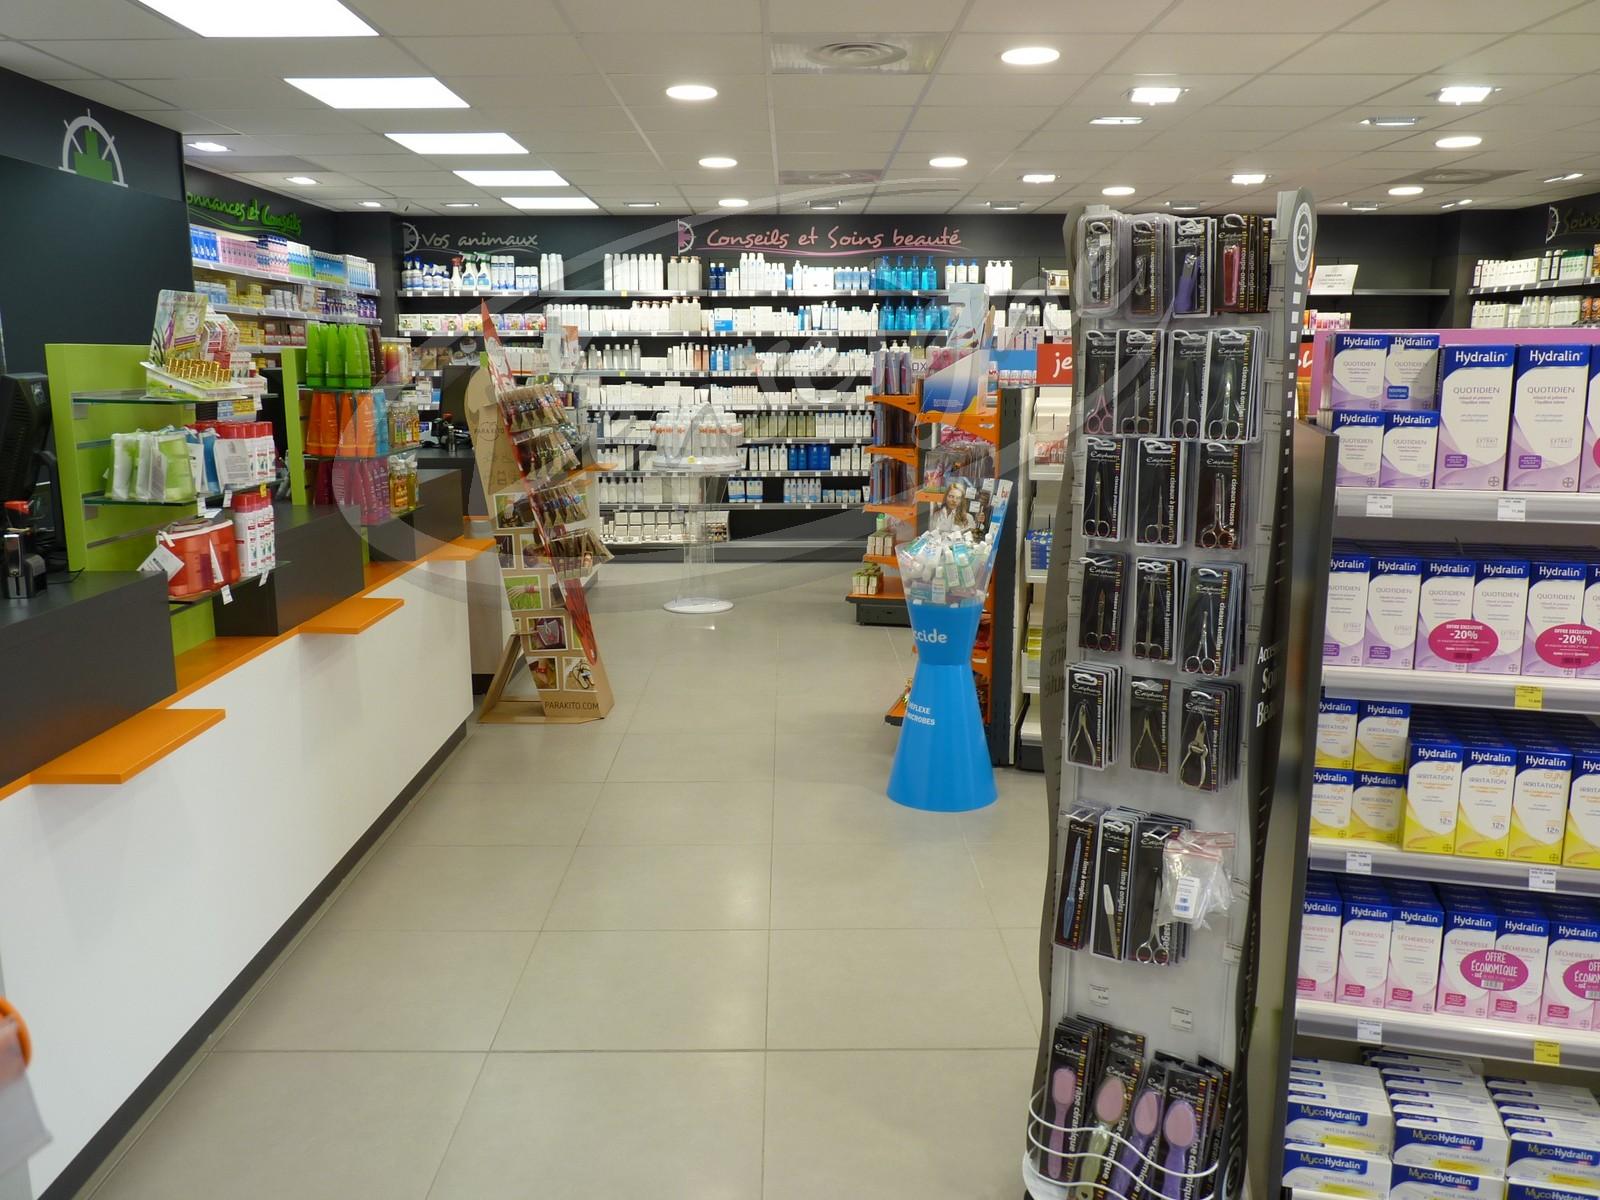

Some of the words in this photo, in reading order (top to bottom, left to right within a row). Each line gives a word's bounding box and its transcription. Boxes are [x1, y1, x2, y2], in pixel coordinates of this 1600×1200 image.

[421, 232, 451, 249] Vos
[458, 232, 538, 247] animaux
[707, 229, 789, 247] Conseils
[799, 226, 818, 246] et
[828, 226, 890, 248] Soins
[892, 228, 962, 246] beauté
[1343, 337, 1380, 347] Hydralin
[1395, 337, 1431, 347] Hydralin
[1455, 351, 1504, 365] Hydralin
[1529, 350, 1579, 364] Hydralin
[1527, 386, 1575, 394] QUOTIDIEN
[1340, 413, 1377, 425] Hydralin
[1393, 415, 1430, 426] Hydralin
[1378, 561, 1416, 572] Hydralin
[1430, 563, 1469, 574] Hydralin
[1484, 564, 1524, 576] Hydralin
[1539, 566, 1580, 578] Hydralin
[1449, 630, 1478, 639] -20%
[1558, 635, 1587, 644] -20%
[1367, 704, 1403, 715] Hydralin
[1418, 748, 1457, 759] Hydralin
[1471, 752, 1511, 762] Hydralin
[1525, 755, 1566, 767] Hydralin
[1361, 774, 1396, 785] Hydralin
[1078, 883, 1086, 900] ongles
[1351, 906, 1388, 918] Hydralin
[1401, 911, 1438, 923] Hydralin
[1454, 915, 1491, 927] Hydralin
[1505, 920, 1543, 933] Hydralin
[1302, 925, 1334, 933] CHERESSE
[1558, 926, 1597, 938] Hydralin
[1485, 951, 1506, 963] OFFRE
[1471, 960, 1518, 977] ÉCONOMIQUE
[1301, 1104, 1361, 1121] MycoHydralin
[1412, 1129, 1476, 1146] MycoHydralin
[1527, 1143, 1593, 1161] MycoHydralin
[1300, 1153, 1360, 1170] MycoHydralin
[1408, 1168, 1472, 1186] MycoHydralin
